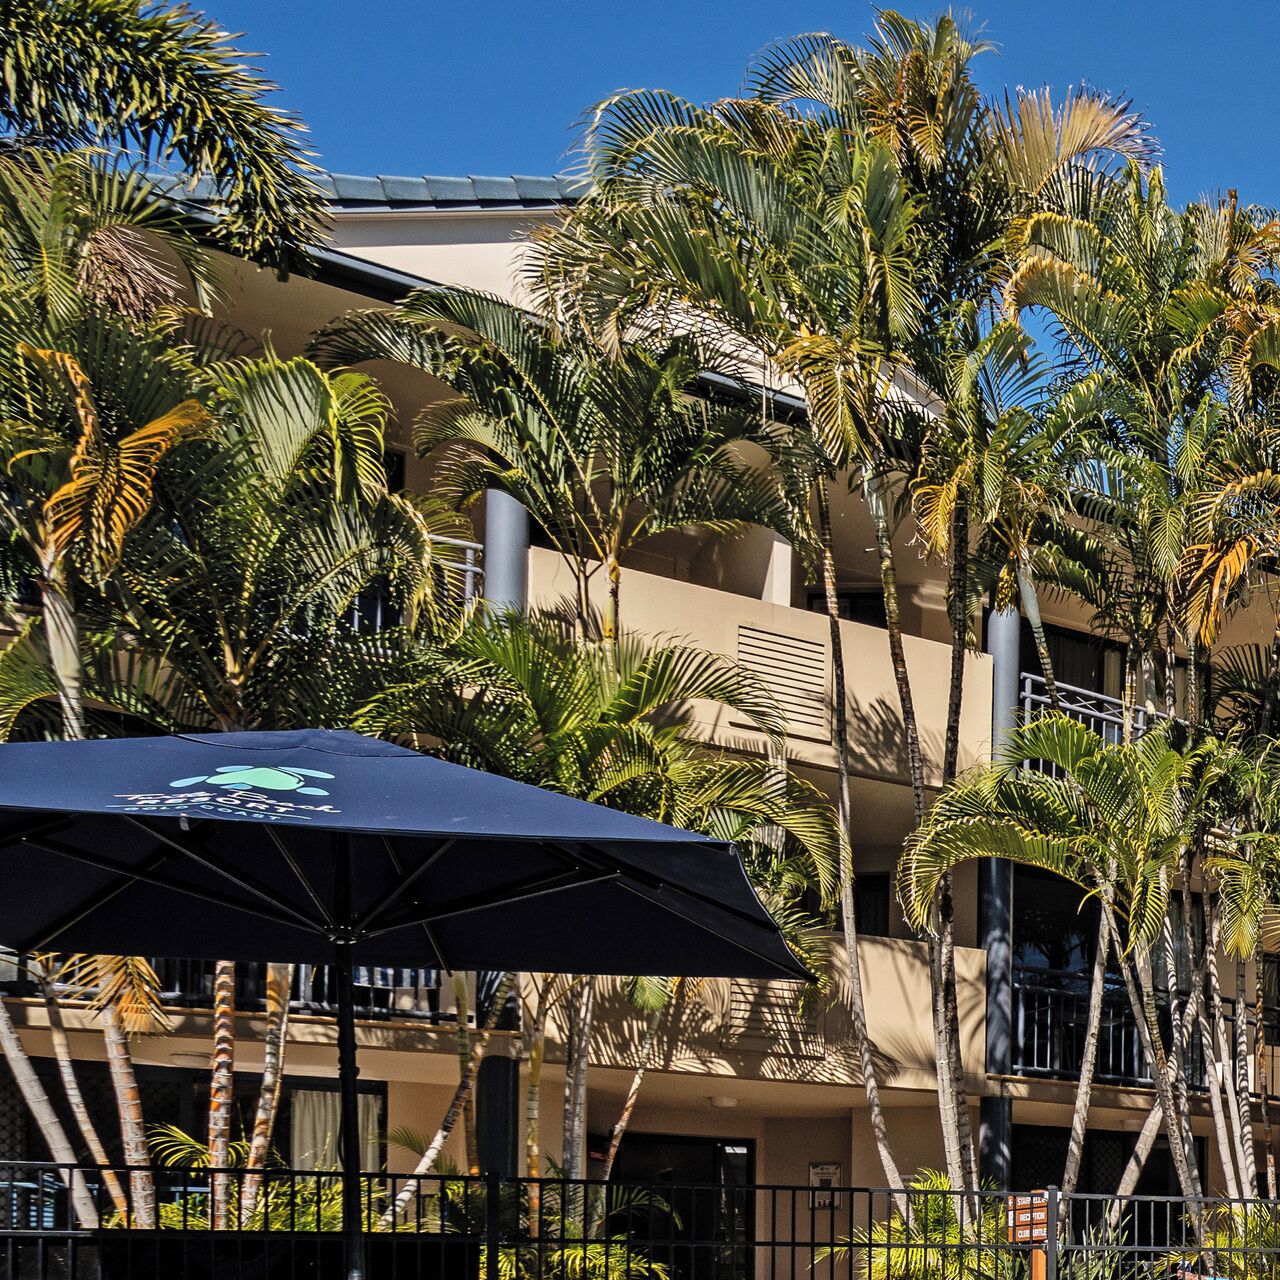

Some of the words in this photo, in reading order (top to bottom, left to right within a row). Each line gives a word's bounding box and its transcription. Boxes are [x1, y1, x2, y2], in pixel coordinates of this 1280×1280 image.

[136, 797, 295, 813] RESORT
[227, 789, 342, 813] Beach
[199, 804, 280, 820] COAST
